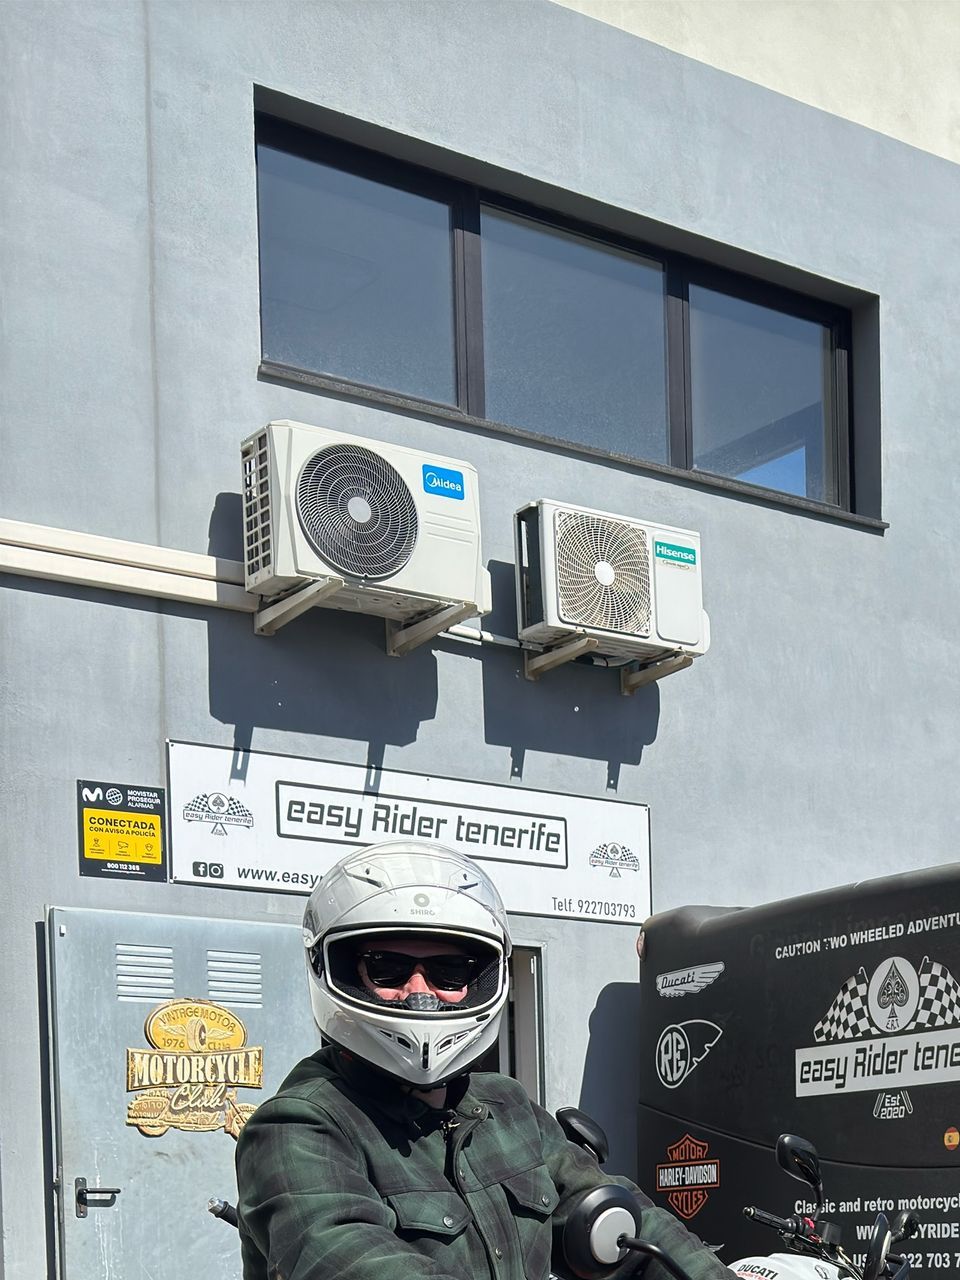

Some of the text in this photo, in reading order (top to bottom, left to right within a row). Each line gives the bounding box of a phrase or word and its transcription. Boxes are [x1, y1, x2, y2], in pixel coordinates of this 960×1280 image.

[425, 471, 462, 492] Midea
[656, 545, 695, 561] Hisense
[127, 789, 158, 798] MOVISTAR
[127, 795, 161, 804] PROSEGUR
[89, 817, 155, 831] CONECTADA
[185, 812, 252, 824] easy Rider tenerife
[287, 800, 561, 853] easy Rider tenerife
[105, 827, 125, 835] AVISO
[131, 829, 156, 837] POLICÍA
[551, 897, 636, 918] Telf. 922703793
[775, 939, 821, 960] CAUTION
[850, 923, 905, 945] WHEELED
[661, 971, 695, 989] Ducati
[159, 1007, 236, 1033] VINTAGE MOTOR
[162, 1037, 185, 1049] 1976
[661, 1032, 686, 1081] RE
[800, 1056, 848, 1089] easy
[853, 1042, 909, 1078] Rider
[132, 1051, 260, 1088] MOTORCYCLE
[171, 1084, 225, 1110] Club
[885, 1094, 900, 1106] Est
[880, 1107, 905, 1119] 2020
[672, 1139, 703, 1160] MOTOR
[659, 1164, 717, 1187] HARLEY-DAVIDSON
[672, 1190, 703, 1214] CYCLES
[839, 1198, 861, 1213] and
[864, 1197, 894, 1211] retro
[926, 1253, 951, 1269] 703
[737, 1264, 779, 1280] DUCATI
